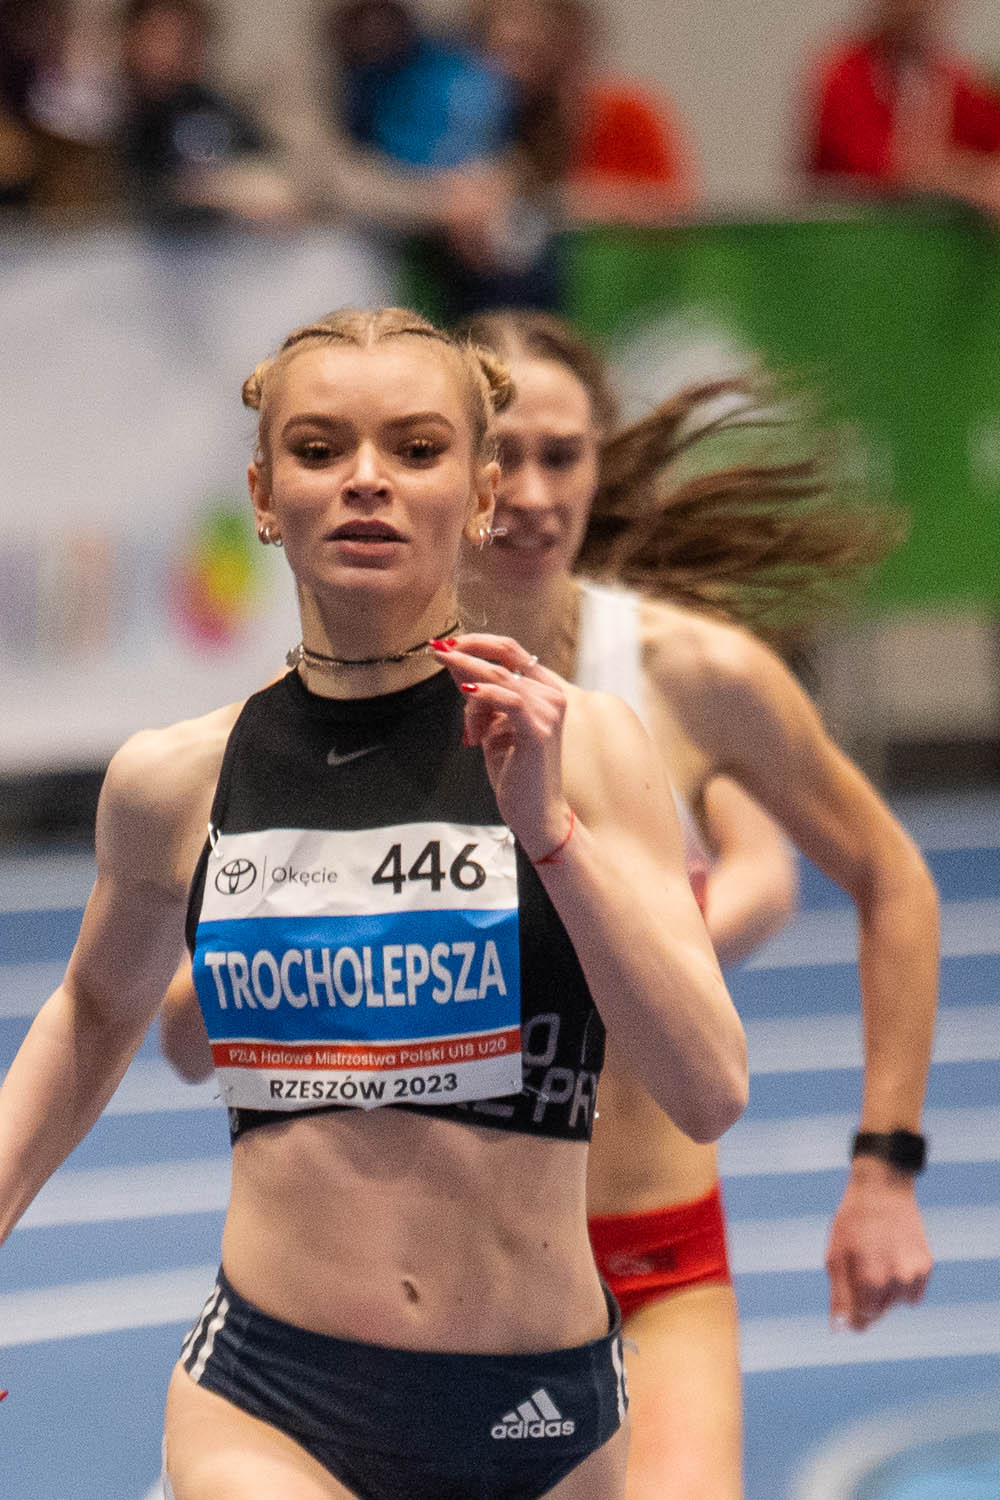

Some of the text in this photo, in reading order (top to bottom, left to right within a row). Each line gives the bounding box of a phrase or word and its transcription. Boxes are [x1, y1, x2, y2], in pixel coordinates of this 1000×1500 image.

[271, 866, 339, 887] Okęcie
[371, 839, 487, 894] 446
[204, 940, 507, 1010] TROCHOLEPSZA
[261, 1049, 313, 1065] Halowe
[315, 1051, 396, 1066] Mistrzostwa
[400, 1047, 445, 1064] Polski
[448, 1043, 475, 1059] U18
[478, 1037, 508, 1055] U20
[269, 1072, 459, 1100] RZESZÓW 2023
[490, 1419, 575, 1439] adidas
